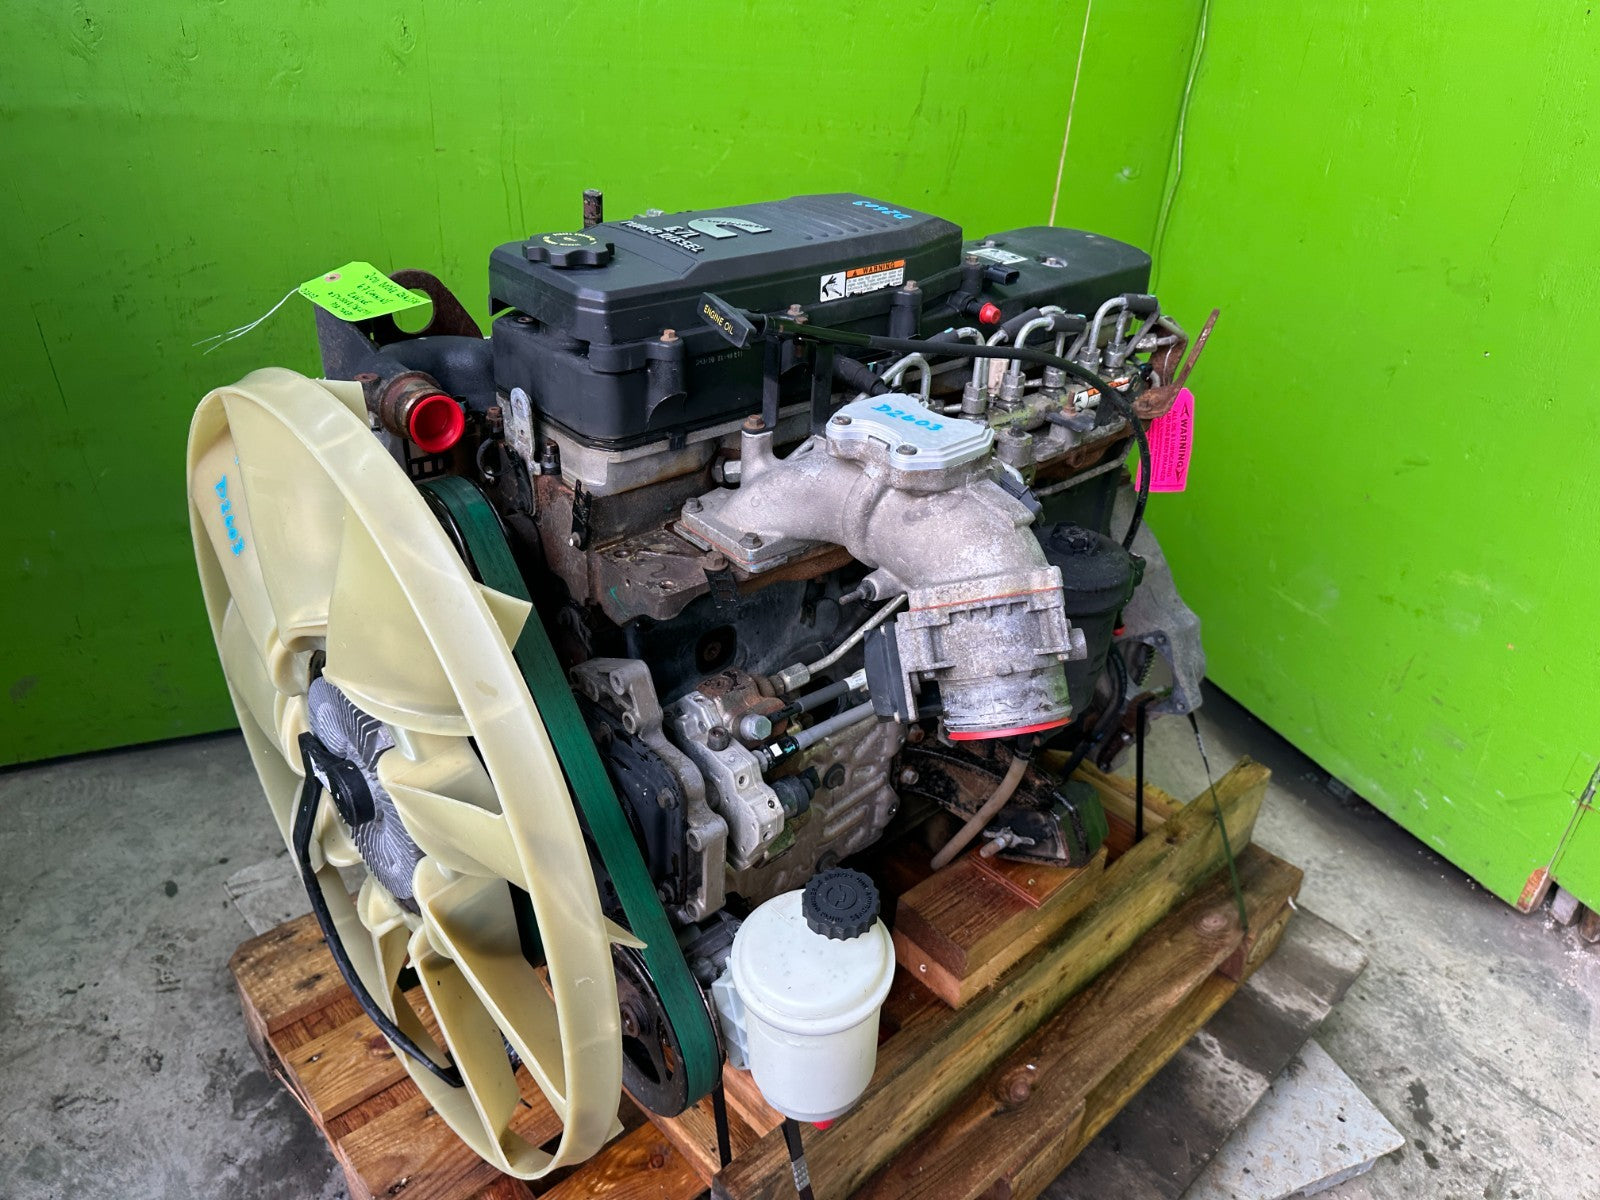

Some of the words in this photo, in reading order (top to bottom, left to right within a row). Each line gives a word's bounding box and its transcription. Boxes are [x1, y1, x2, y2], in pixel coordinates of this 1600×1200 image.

[658, 233, 705, 253] DIESEL
[863, 262, 895, 274] WARNING
[703, 304, 725, 326] ENGINE
[723, 322, 734, 335] OIL
[870, 404, 943, 431] D2603
[1177, 419, 1188, 468] WARNING
[214, 473, 245, 556] D2603
